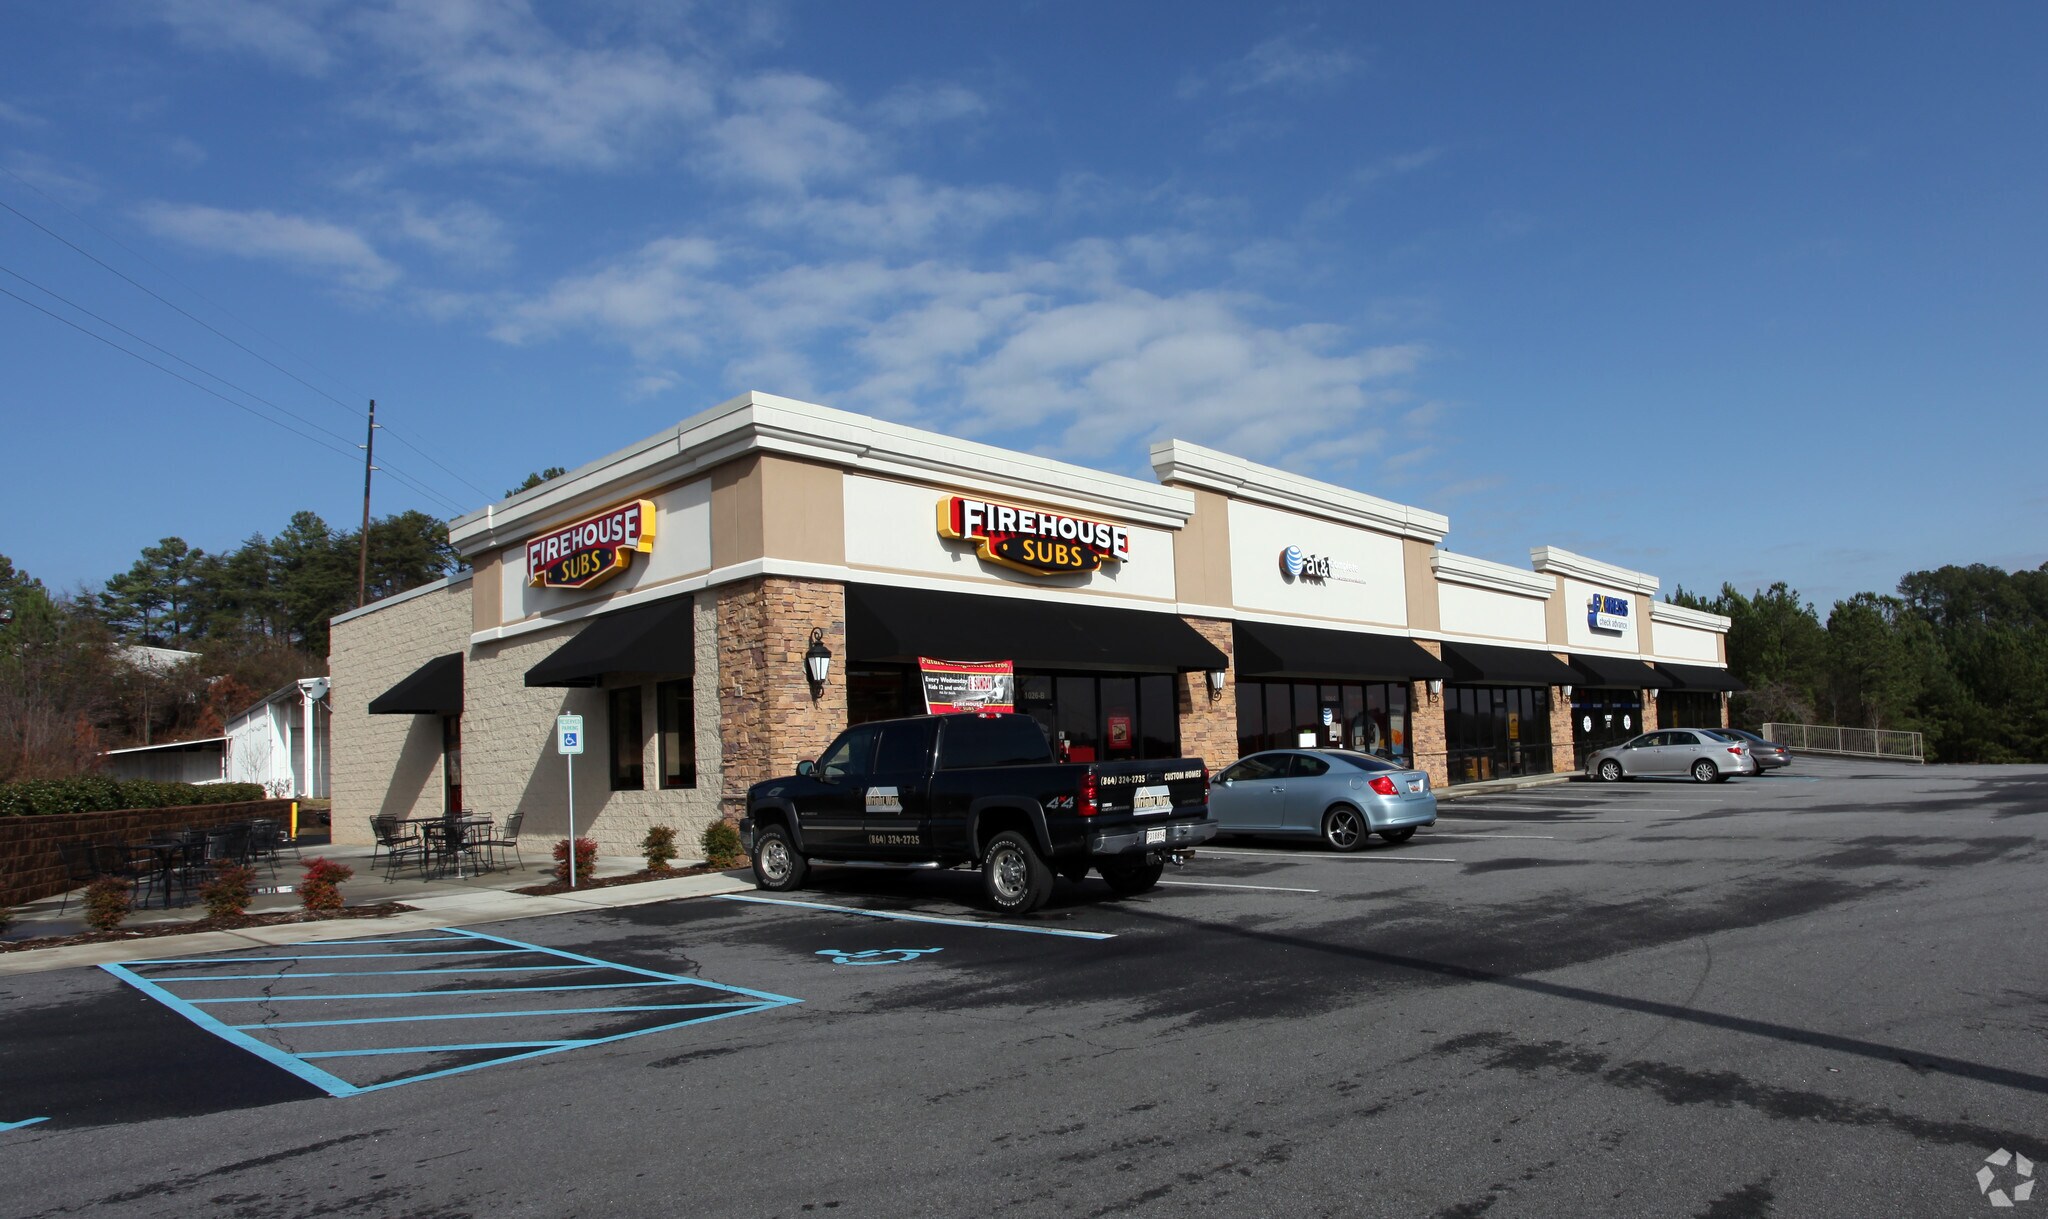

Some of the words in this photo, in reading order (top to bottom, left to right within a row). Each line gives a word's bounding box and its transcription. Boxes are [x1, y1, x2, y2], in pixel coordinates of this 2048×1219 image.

[963, 499, 1129, 563] FIREHOUSE
[530, 508, 639, 581] FIREHOUSE
[1023, 540, 1083, 566] SUBS
[561, 550, 600, 581] SUBS
[1306, 557, 1333, 578] at&t
[1593, 594, 1628, 617] EXPRESS
[1599, 617, 1611, 628] check
[1612, 619, 1628, 630] advance
[925, 676, 939, 684] Every
[940, 677, 968, 686] Wednesday
[1024, 691, 1045, 700] 1026-B
[953, 701, 984, 709] FIREHOUSE
[1100, 776, 1117, 786] (864)
[1164, 771, 1184, 781] CUSTOM
[1185, 769, 1202, 779] HOMES
[868, 834, 886, 845] (864)
[887, 834, 920, 845] 324-2735
